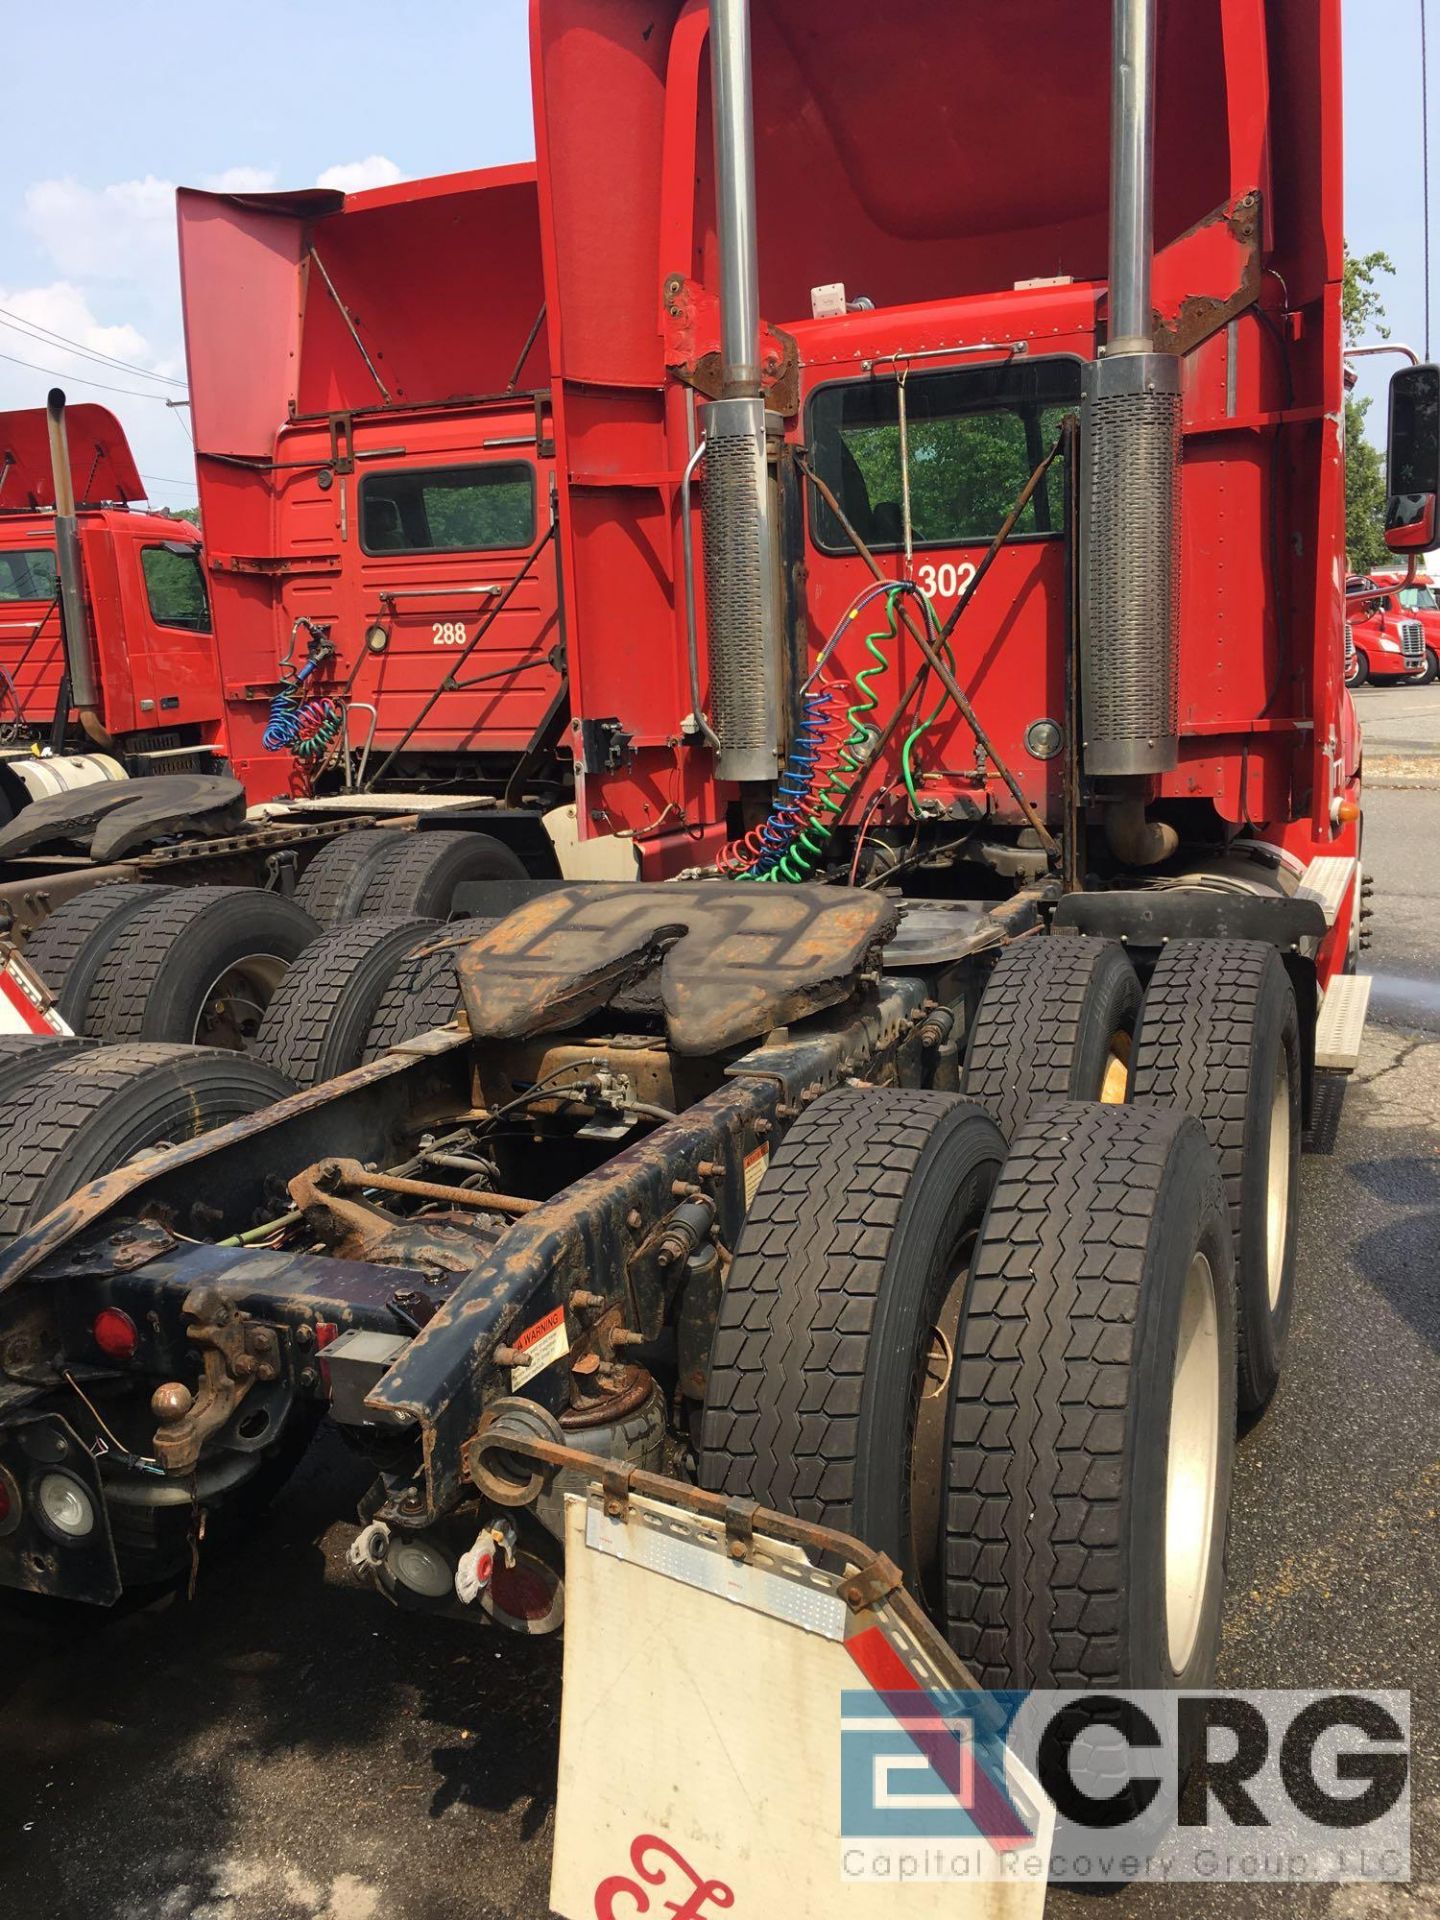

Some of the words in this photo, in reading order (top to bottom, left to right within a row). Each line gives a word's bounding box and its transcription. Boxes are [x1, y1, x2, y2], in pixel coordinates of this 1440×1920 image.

[918, 562, 977, 598] 302
[432, 622, 467, 645] 288
[523, 1313, 560, 1344] WARNING
